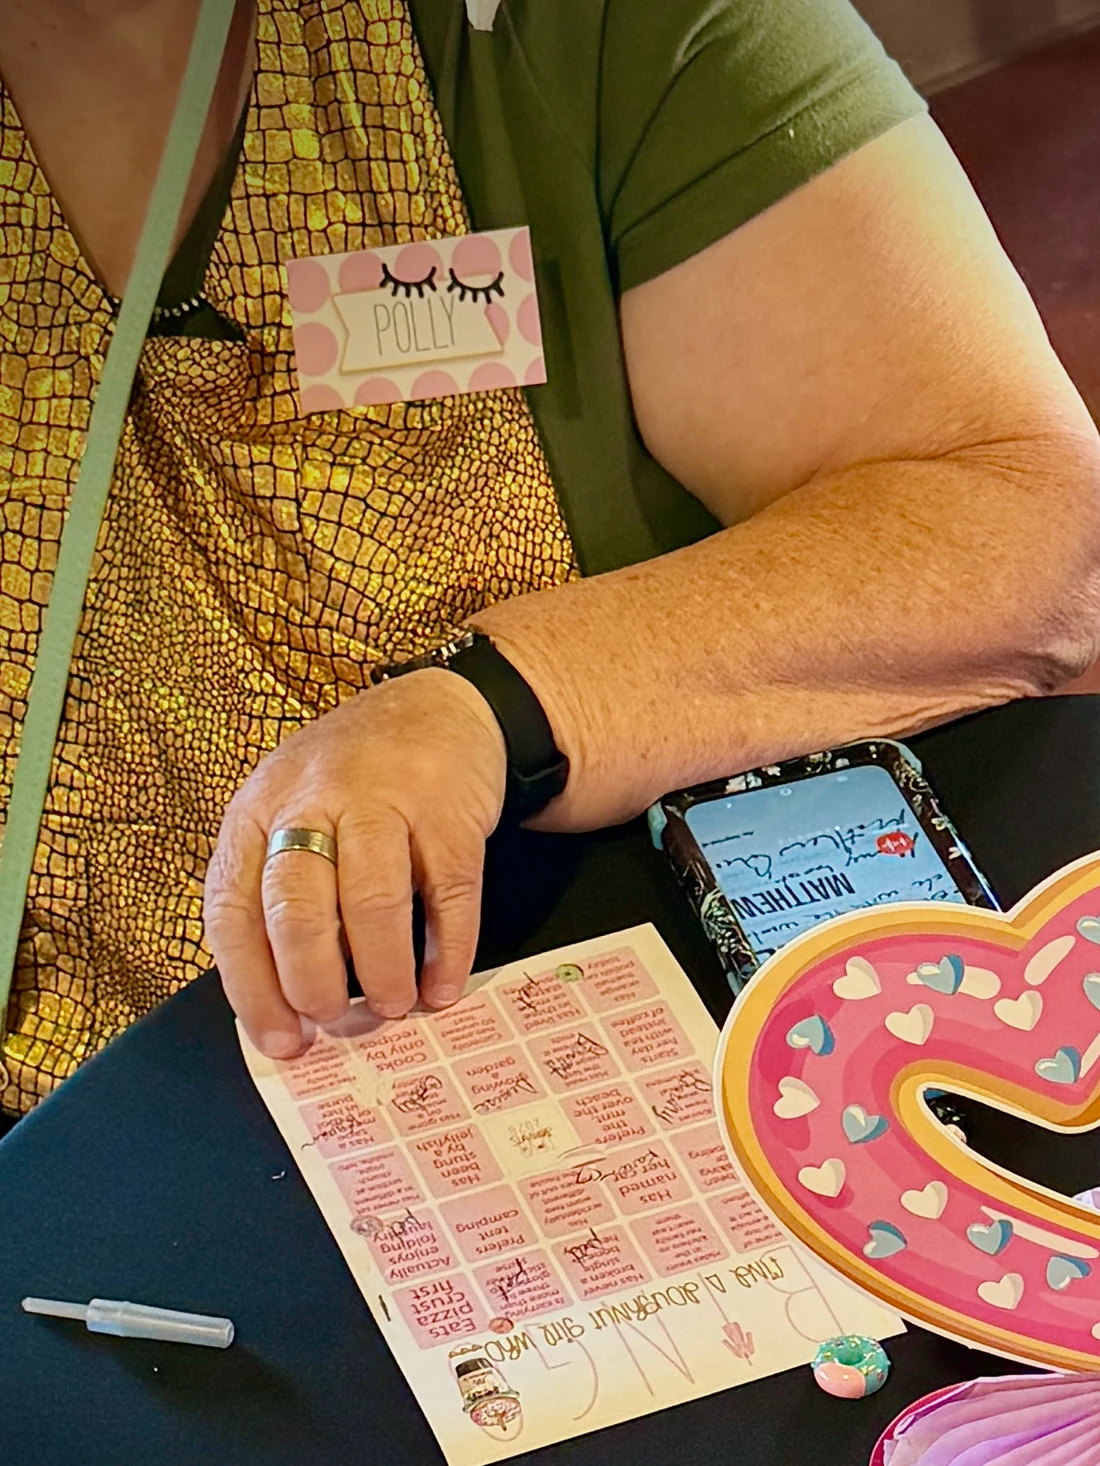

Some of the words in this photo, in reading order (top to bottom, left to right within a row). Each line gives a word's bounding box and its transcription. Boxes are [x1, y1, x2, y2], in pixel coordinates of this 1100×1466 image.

[373, 295, 458, 357] POLLY
[415, 1126, 473, 1151] jellyfish
[447, 1143, 467, 1153] by
[432, 1150, 476, 1169] stung
[440, 1161, 481, 1178] been
[451, 1173, 480, 1186] Has
[455, 1209, 519, 1233] camping
[478, 1225, 509, 1240] tent
[475, 1234, 525, 1254] Prefers
[409, 1279, 453, 1300] first
[410, 1289, 465, 1315] crust
[416, 1300, 473, 1326] pizza
[428, 1317, 476, 1338] Eats
